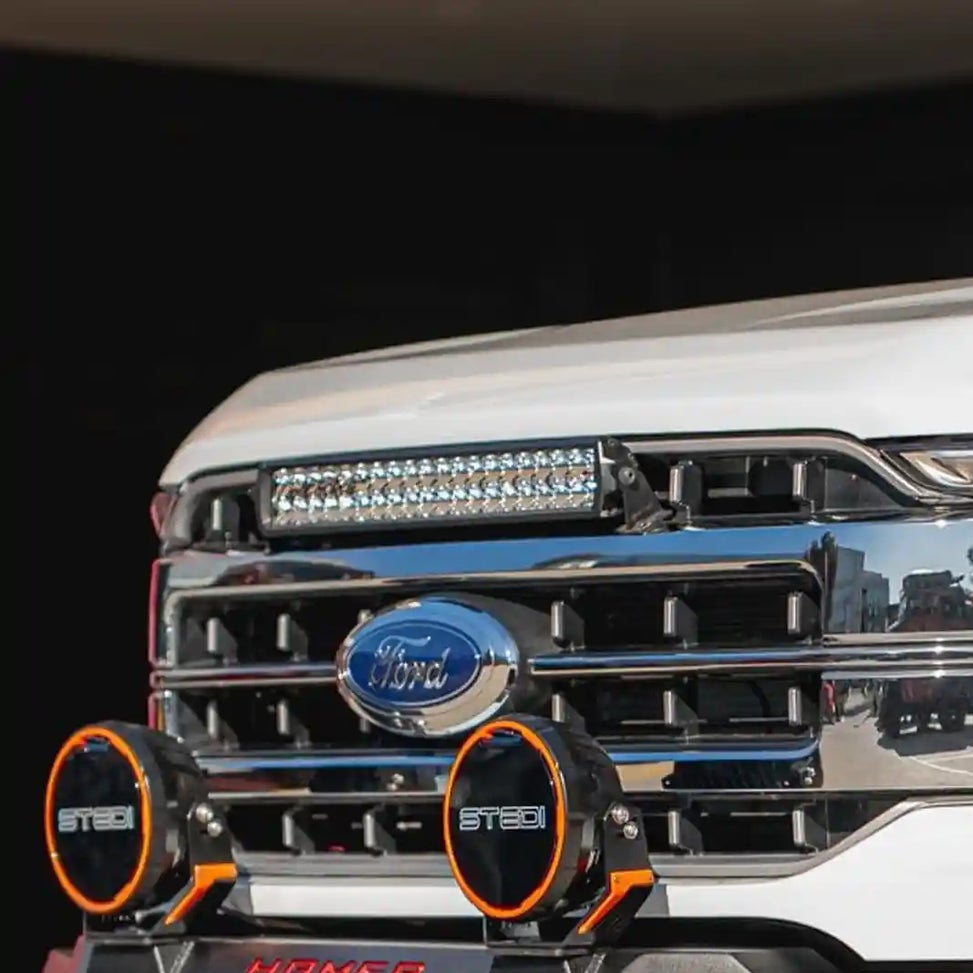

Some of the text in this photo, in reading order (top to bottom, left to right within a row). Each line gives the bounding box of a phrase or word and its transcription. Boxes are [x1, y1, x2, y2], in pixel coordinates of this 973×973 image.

[368, 635, 451, 691] Ford
[58, 805, 134, 832] STEDI
[459, 805, 545, 831] STEDI
